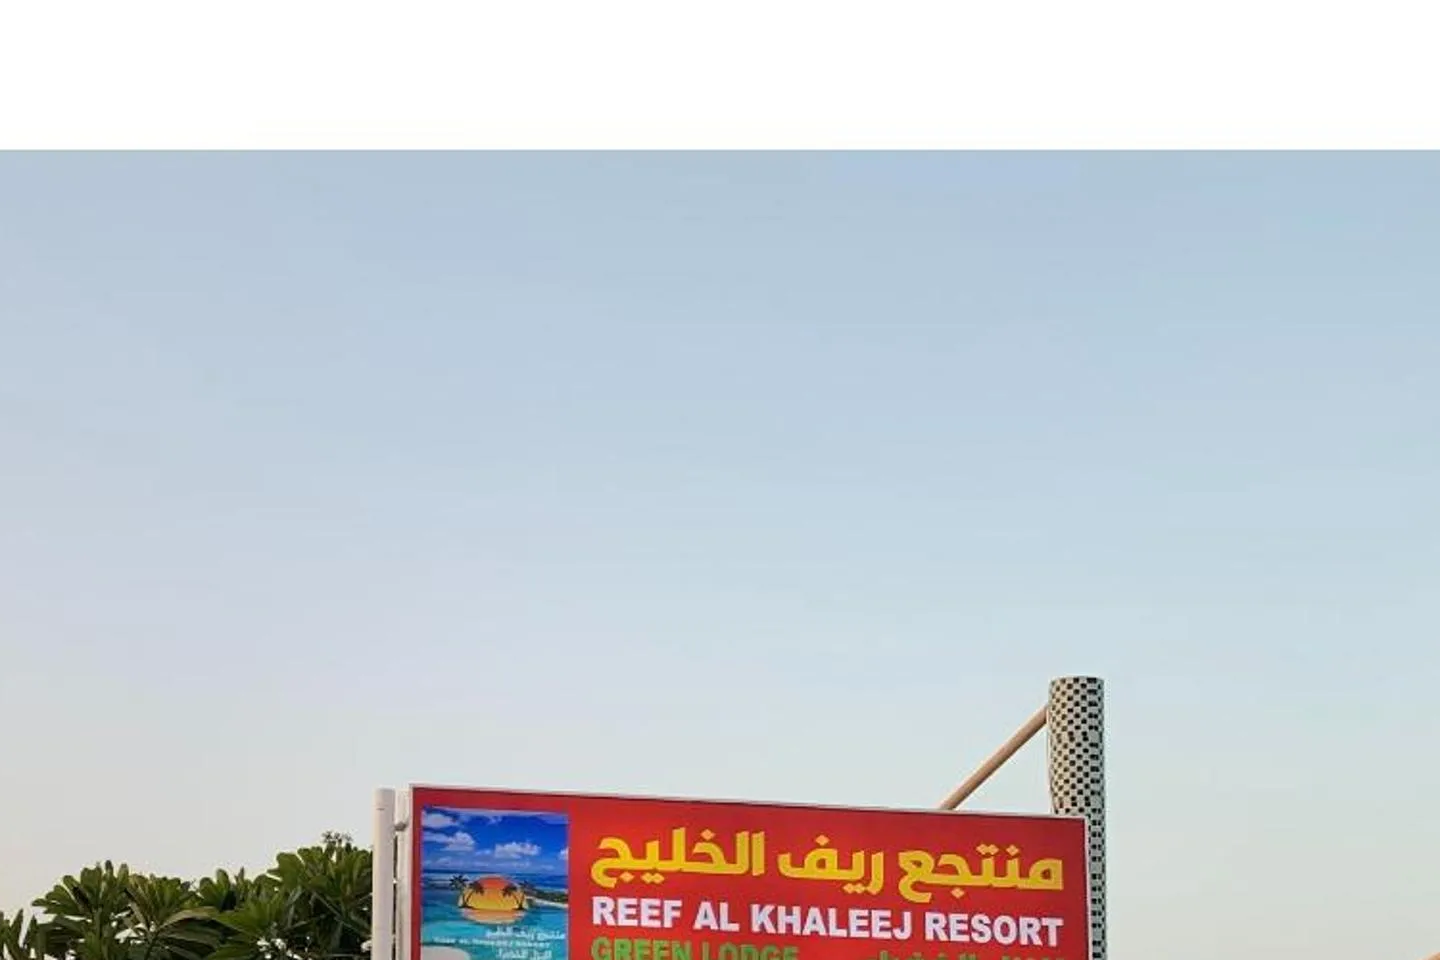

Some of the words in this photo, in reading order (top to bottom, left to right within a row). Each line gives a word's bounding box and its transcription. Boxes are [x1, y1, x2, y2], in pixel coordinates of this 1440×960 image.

[590, 827, 766, 888] الخليج
[777, 834, 885, 896] ريف
[898, 844, 1064, 903] منتجع
[592, 896, 683, 929] REEF
[693, 902, 740, 932] AL
[751, 903, 912, 940] KHALEEJ
[925, 911, 1064, 947] RESORT
